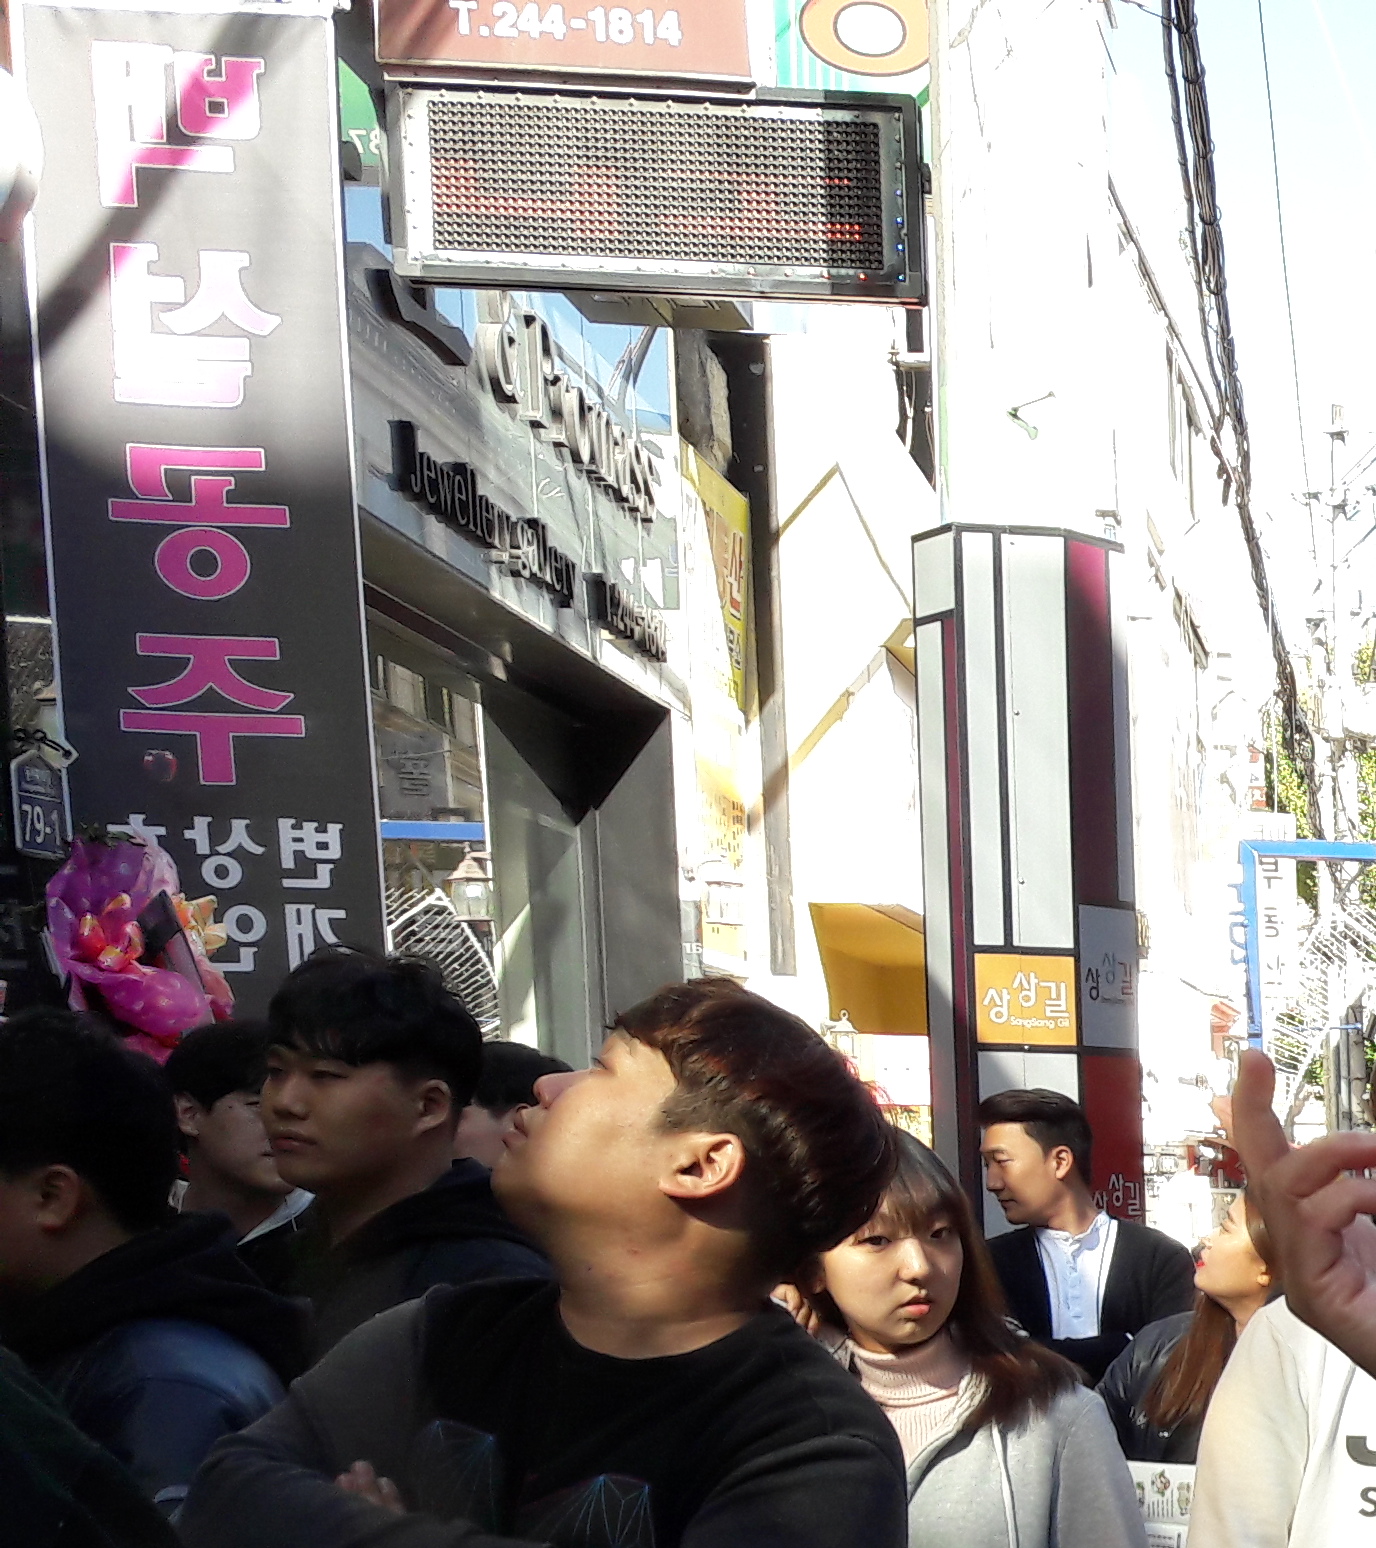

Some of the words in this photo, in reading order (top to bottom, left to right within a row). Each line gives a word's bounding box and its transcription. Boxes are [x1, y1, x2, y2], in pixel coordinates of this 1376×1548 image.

[449, 0, 684, 47] T.244-1814
[410, 451, 512, 551] Jewellery
[516, 517, 578, 604] gallery
[20, 804, 62, 846] 79-1
[982, 971, 1070, 1024] 상상길
[1085, 951, 1134, 1001] 상상길
[1010, 1016, 1056, 1030] SangSang
[1057, 1017, 1070, 1028] Gil
